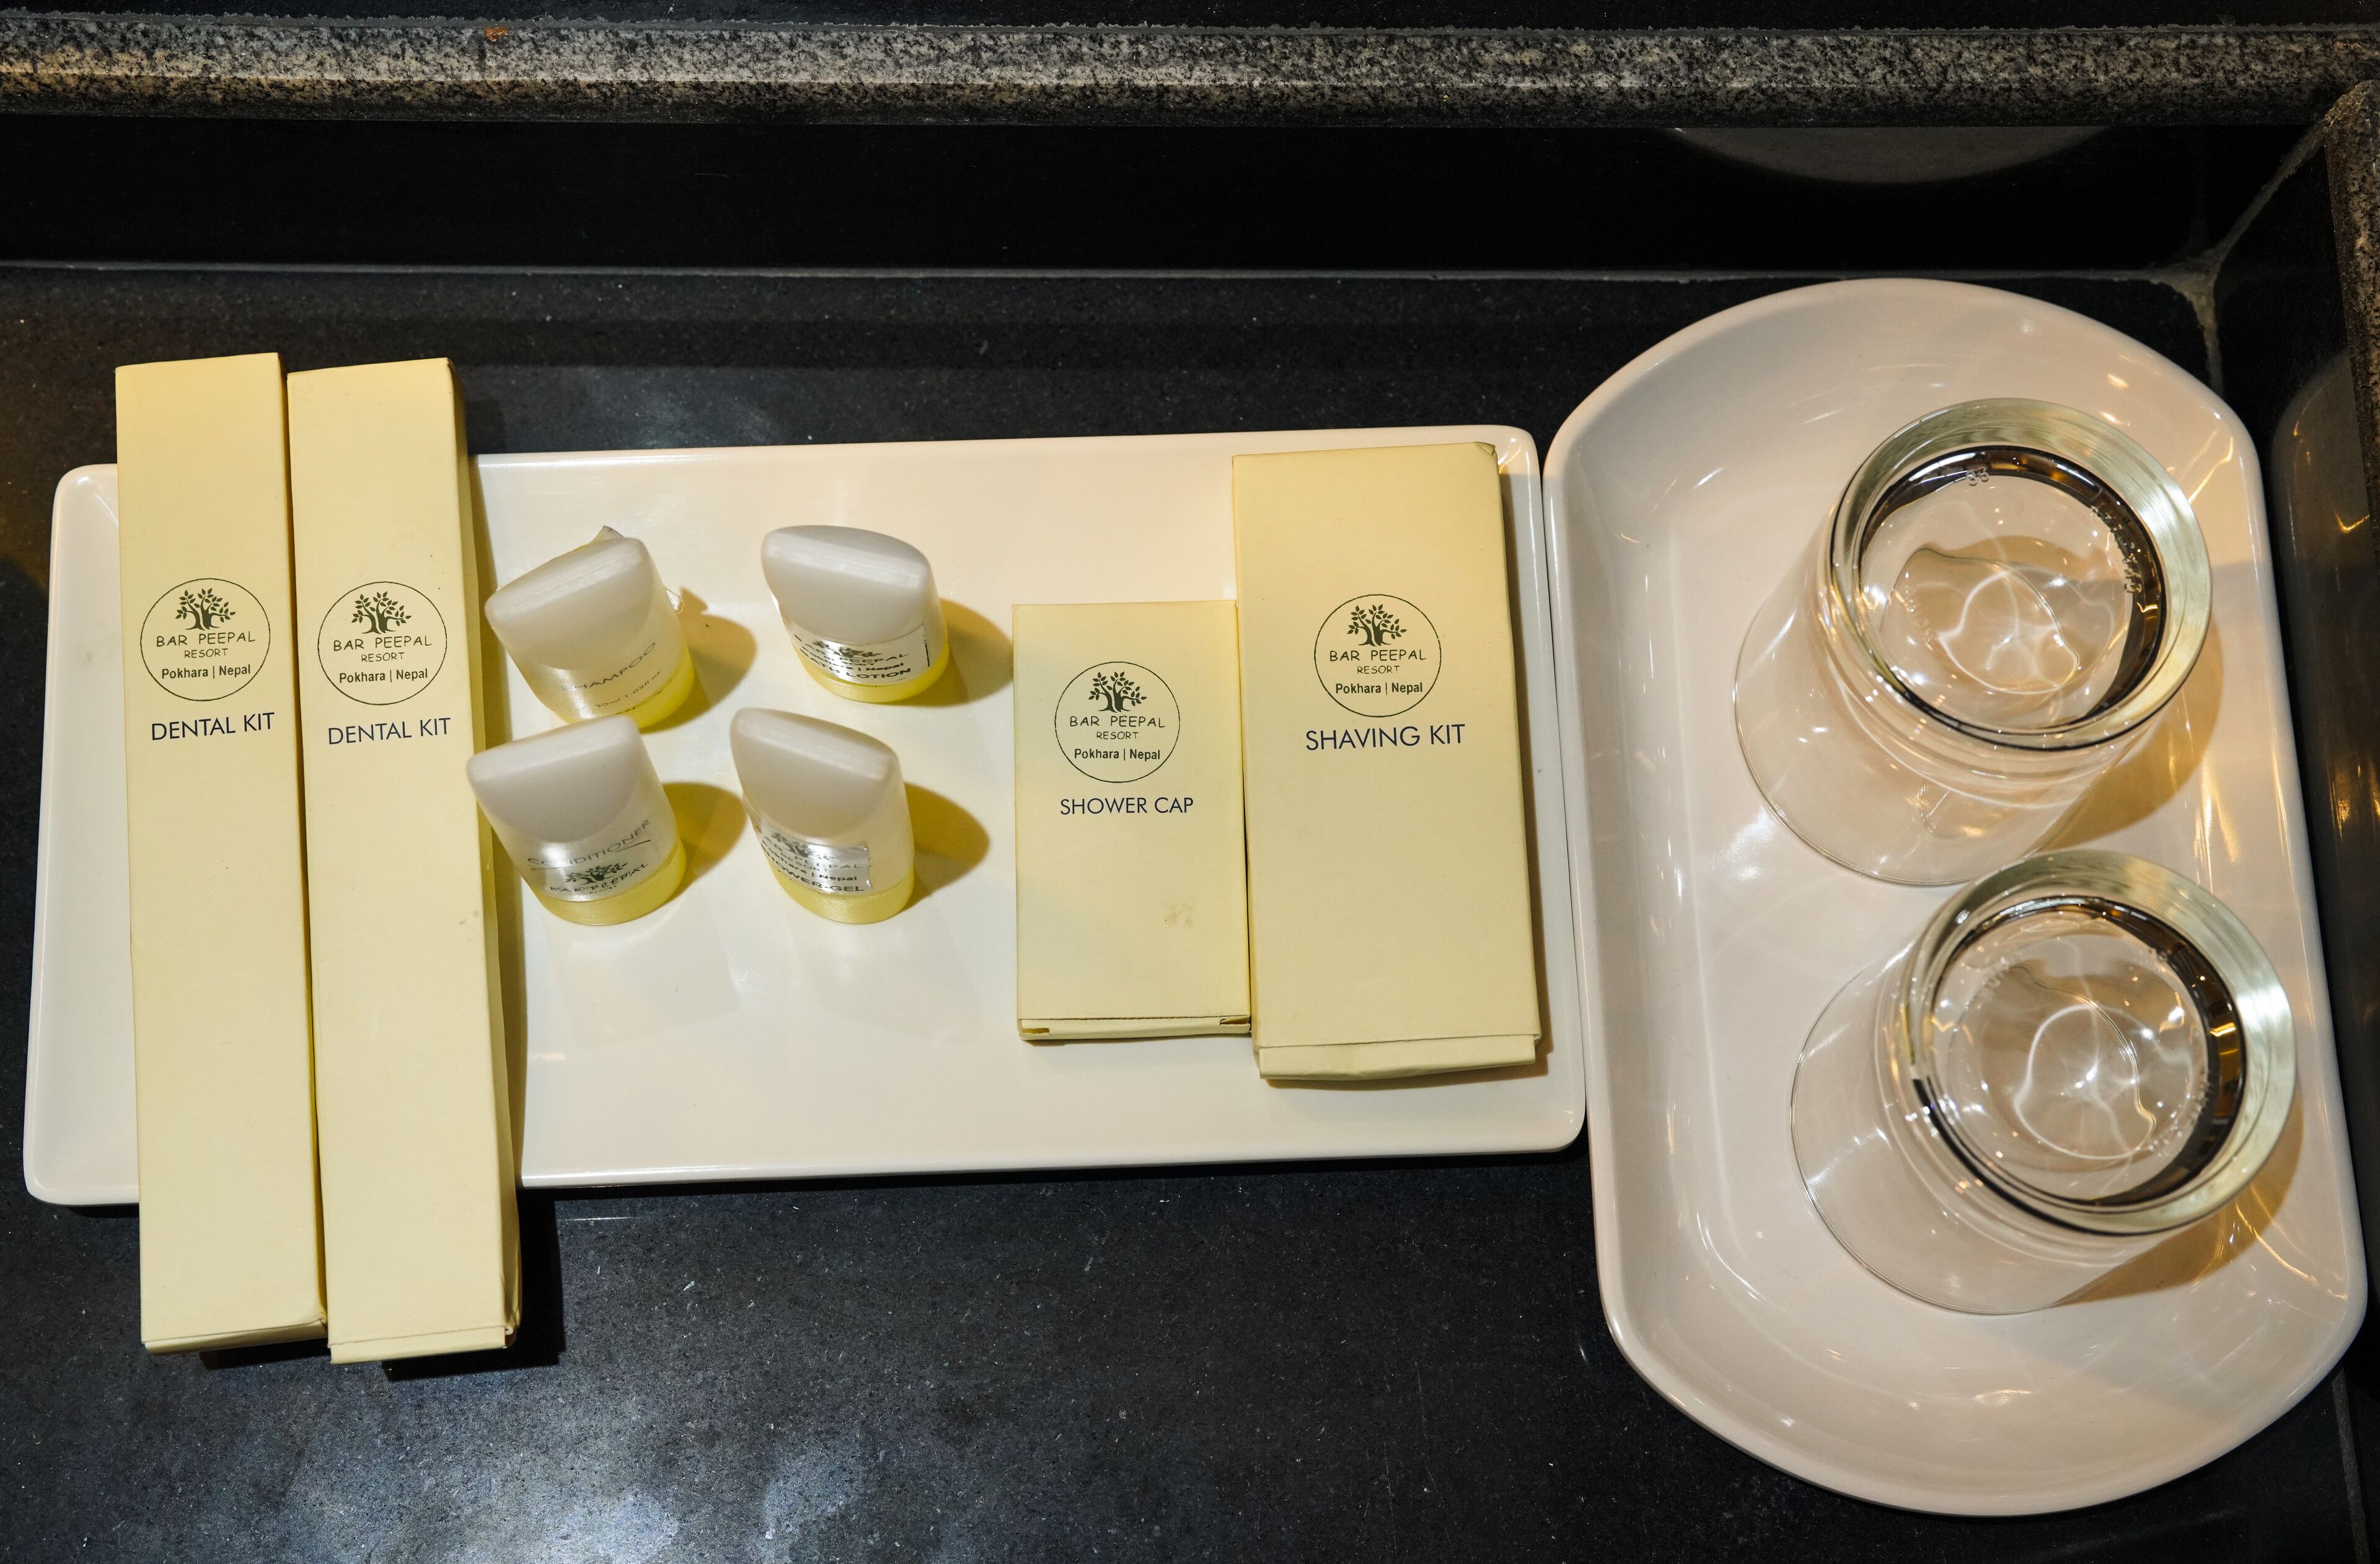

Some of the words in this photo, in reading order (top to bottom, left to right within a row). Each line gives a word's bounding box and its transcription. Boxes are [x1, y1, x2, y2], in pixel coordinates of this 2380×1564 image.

[156, 634, 188, 648] BAR
[198, 630, 256, 645] PEEPAL
[333, 638, 364, 652] BAR
[374, 634, 433, 649] PEEPAL
[184, 648, 229, 659] RESORT
[361, 652, 405, 663] RESORT
[839, 653, 909, 663] EEPAL
[1329, 650, 1360, 662] BAR
[1370, 648, 1427, 661] PEEPAL
[161, 667, 209, 679] Pokhara
[219, 663, 251, 677] Nepal
[339, 671, 386, 684] Pokhara
[396, 668, 428, 682] Nepal
[845, 668, 911, 679] LOTION
[1357, 665, 1400, 674] RESORT
[1335, 683, 1382, 694] Pokhara
[1391, 681, 1423, 695] Nepal
[151, 716, 236, 741] DENTAL
[244, 712, 275, 732] KIT
[1070, 715, 1100, 727] BAR
[1110, 715, 1166, 728] PEEPAL
[328, 721, 412, 745] DENTAL
[420, 717, 451, 737] KIT
[1096, 731, 1139, 740] RESORT
[1306, 725, 1421, 751] SHAVING
[1430, 723, 1466, 745] KIT
[1074, 748, 1119, 760] Pokhara
[1129, 748, 1161, 762] Nepal
[1060, 797, 1148, 815] SHOWER
[1154, 797, 1194, 814] CAP
[526, 818, 651, 865] CODITIONER
[760, 842, 865, 892] OWER-GEL
[819, 873, 857, 881] Nepal
